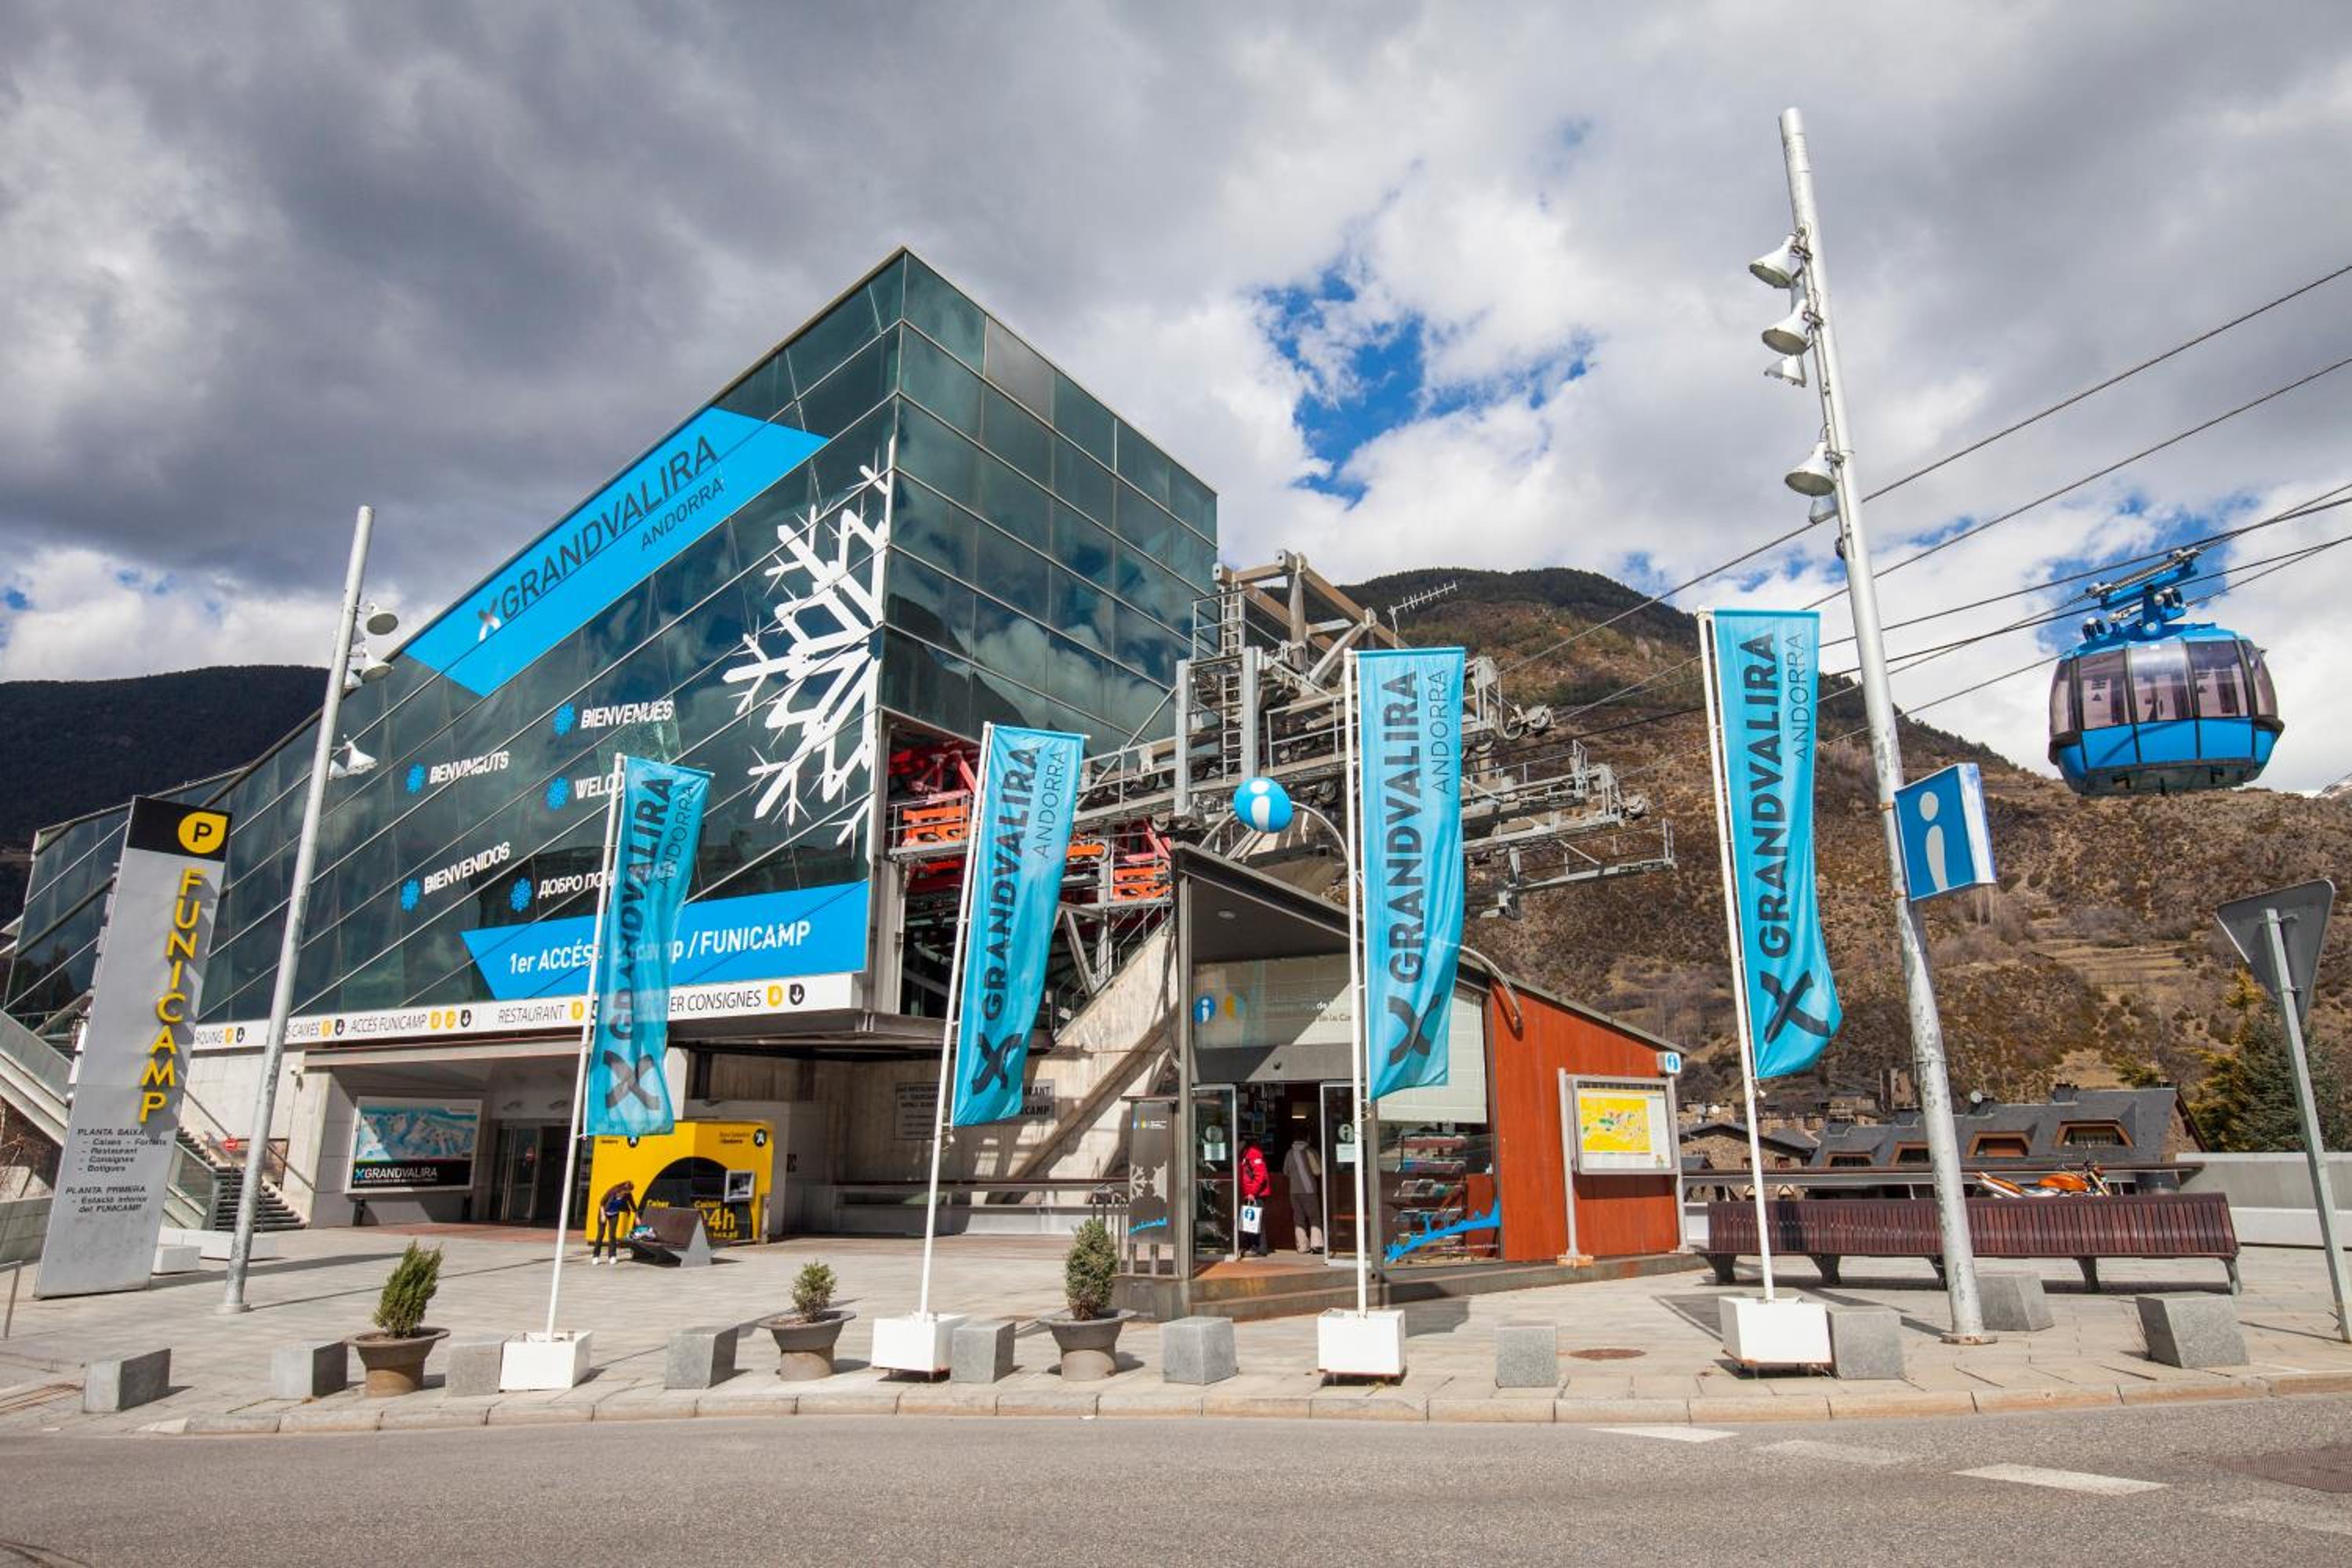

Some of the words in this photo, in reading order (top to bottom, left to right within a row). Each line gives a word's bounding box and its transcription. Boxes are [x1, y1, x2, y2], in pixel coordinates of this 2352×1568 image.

[502, 435, 718, 619] GRANDVALIRA
[641, 477, 725, 550] ANDORRA
[580, 700, 674, 728] BIENVENUES
[1785, 633, 1809, 764] ANDORRA
[1428, 670, 1450, 794] ANDORRA
[430, 751, 510, 784] BENVINGUTS
[1739, 633, 1791, 958] GRANDVALIRA
[193, 821, 212, 843] P
[657, 786, 694, 887] ANDORRA
[1033, 752, 1065, 859] ANDORRA
[1381, 671, 1425, 983] GRANDVALIRA
[424, 841, 510, 895] BIENVENIDOS
[538, 874, 583, 899] ДОБРО
[982, 746, 1040, 1020] GRANDVALIRA
[138, 868, 208, 1123] FUNICAMP
[510, 953, 536, 975] 1er
[379, 1014, 426, 1031] FUNICAMP
[498, 1004, 565, 1024] RESTAURANT
[687, 990, 761, 1011] CONSIGNES
[365, 1167, 437, 1179] GRANDVALIRA
